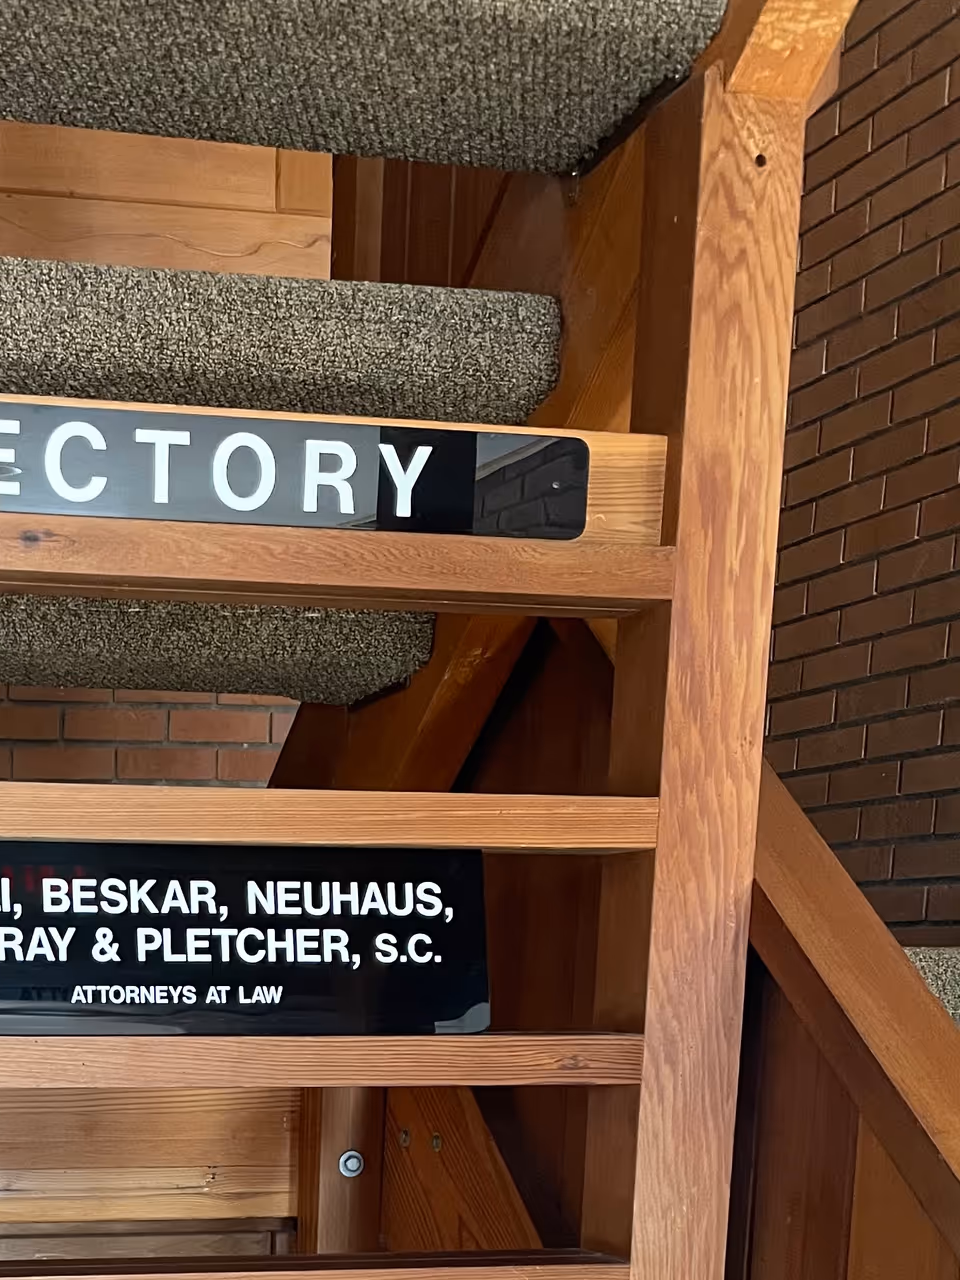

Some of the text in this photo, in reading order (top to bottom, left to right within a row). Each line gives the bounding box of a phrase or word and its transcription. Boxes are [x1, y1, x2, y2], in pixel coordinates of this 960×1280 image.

[42, 877, 229, 922] BESKAR,
[247, 880, 455, 923] NEUHAUS,
[91, 927, 122, 963] &
[136, 927, 362, 970] PLETCHER,
[374, 932, 443, 963] S.C.
[70, 984, 197, 1005] ATTORNEYS
[205, 985, 231, 1004] AT
[238, 985, 284, 1004] LAW
